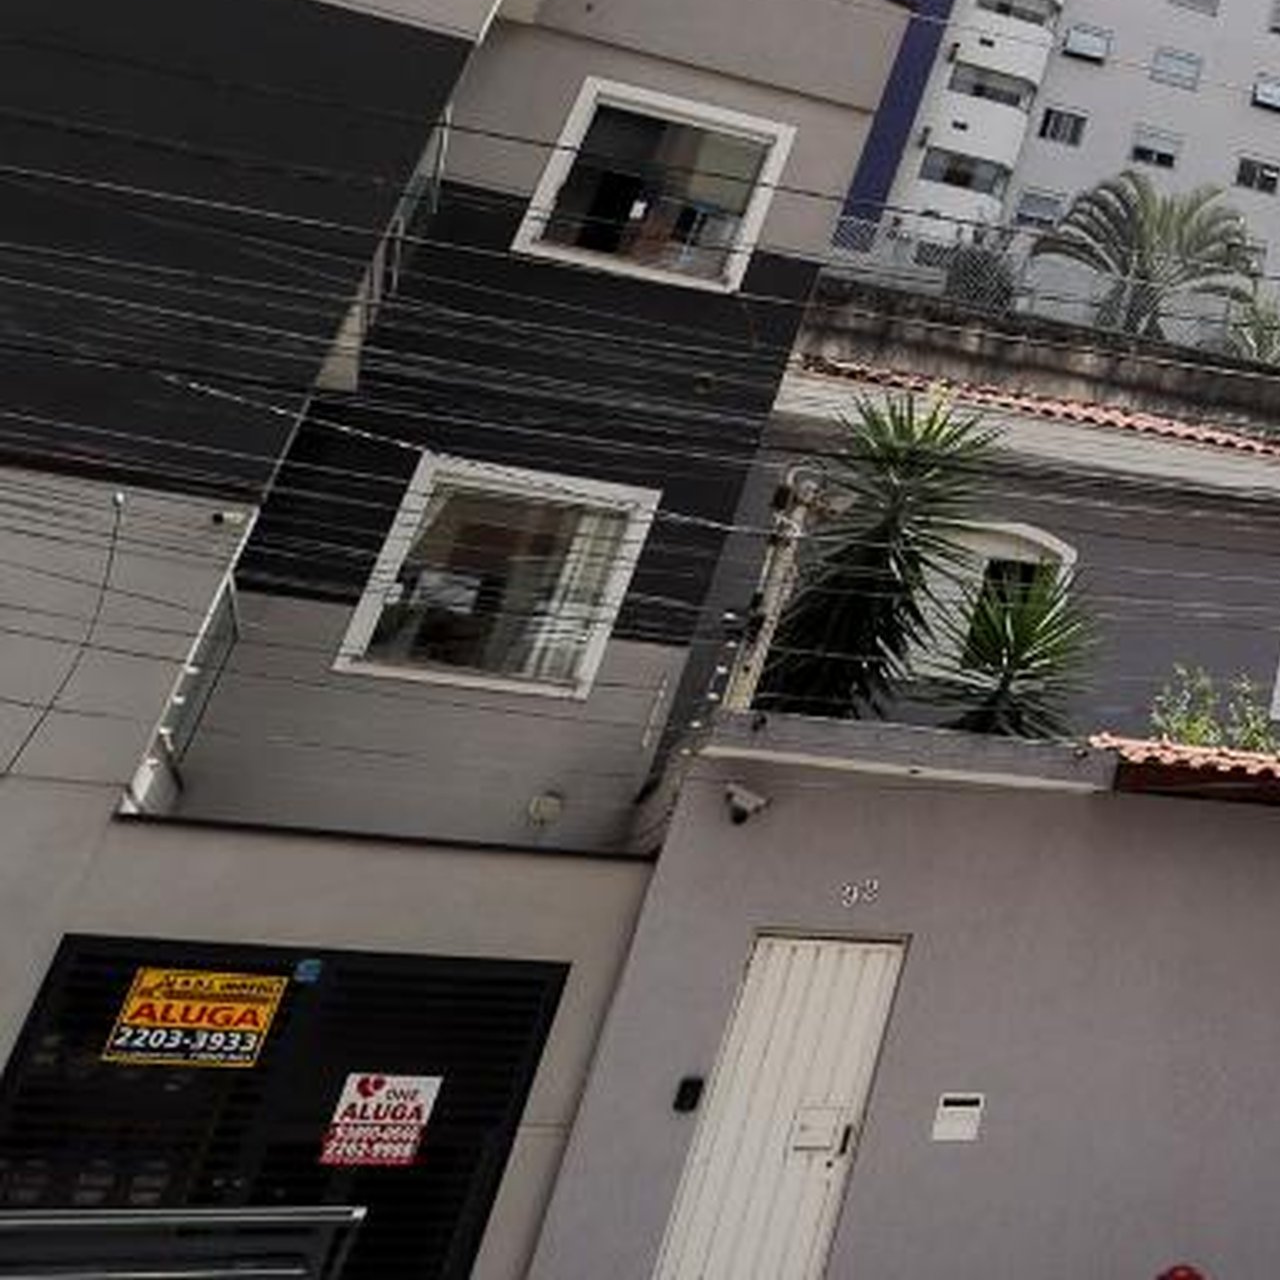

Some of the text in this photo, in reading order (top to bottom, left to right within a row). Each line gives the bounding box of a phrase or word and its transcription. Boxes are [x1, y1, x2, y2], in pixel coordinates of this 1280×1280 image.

[127, 1002, 261, 1027] ALUGA
[114, 1027, 258, 1052] 2203-3933
[341, 1102, 425, 1121] ALUGA
